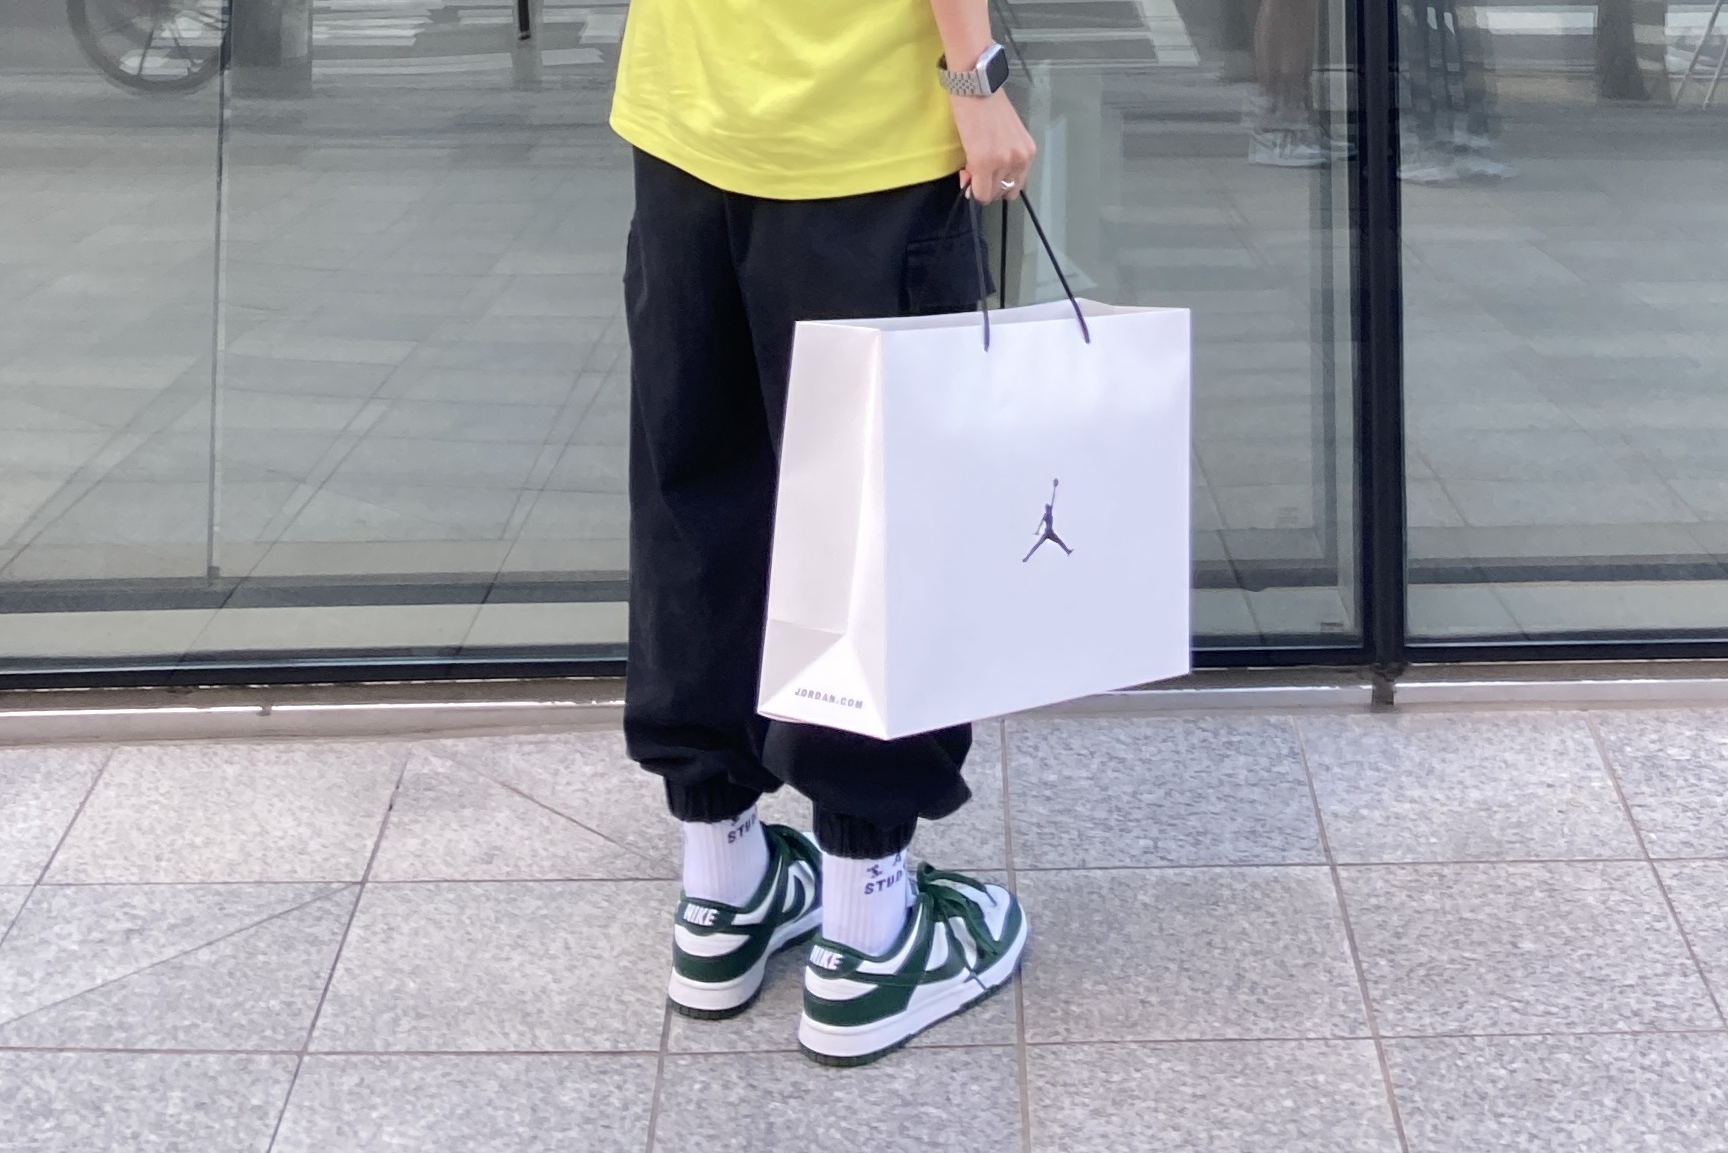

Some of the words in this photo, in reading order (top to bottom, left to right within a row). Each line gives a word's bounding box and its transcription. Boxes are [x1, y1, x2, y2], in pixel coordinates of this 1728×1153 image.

[794, 688, 863, 709] JORDAN.COM
[683, 903, 719, 926] NIKE
[810, 945, 843, 971] NIKE
